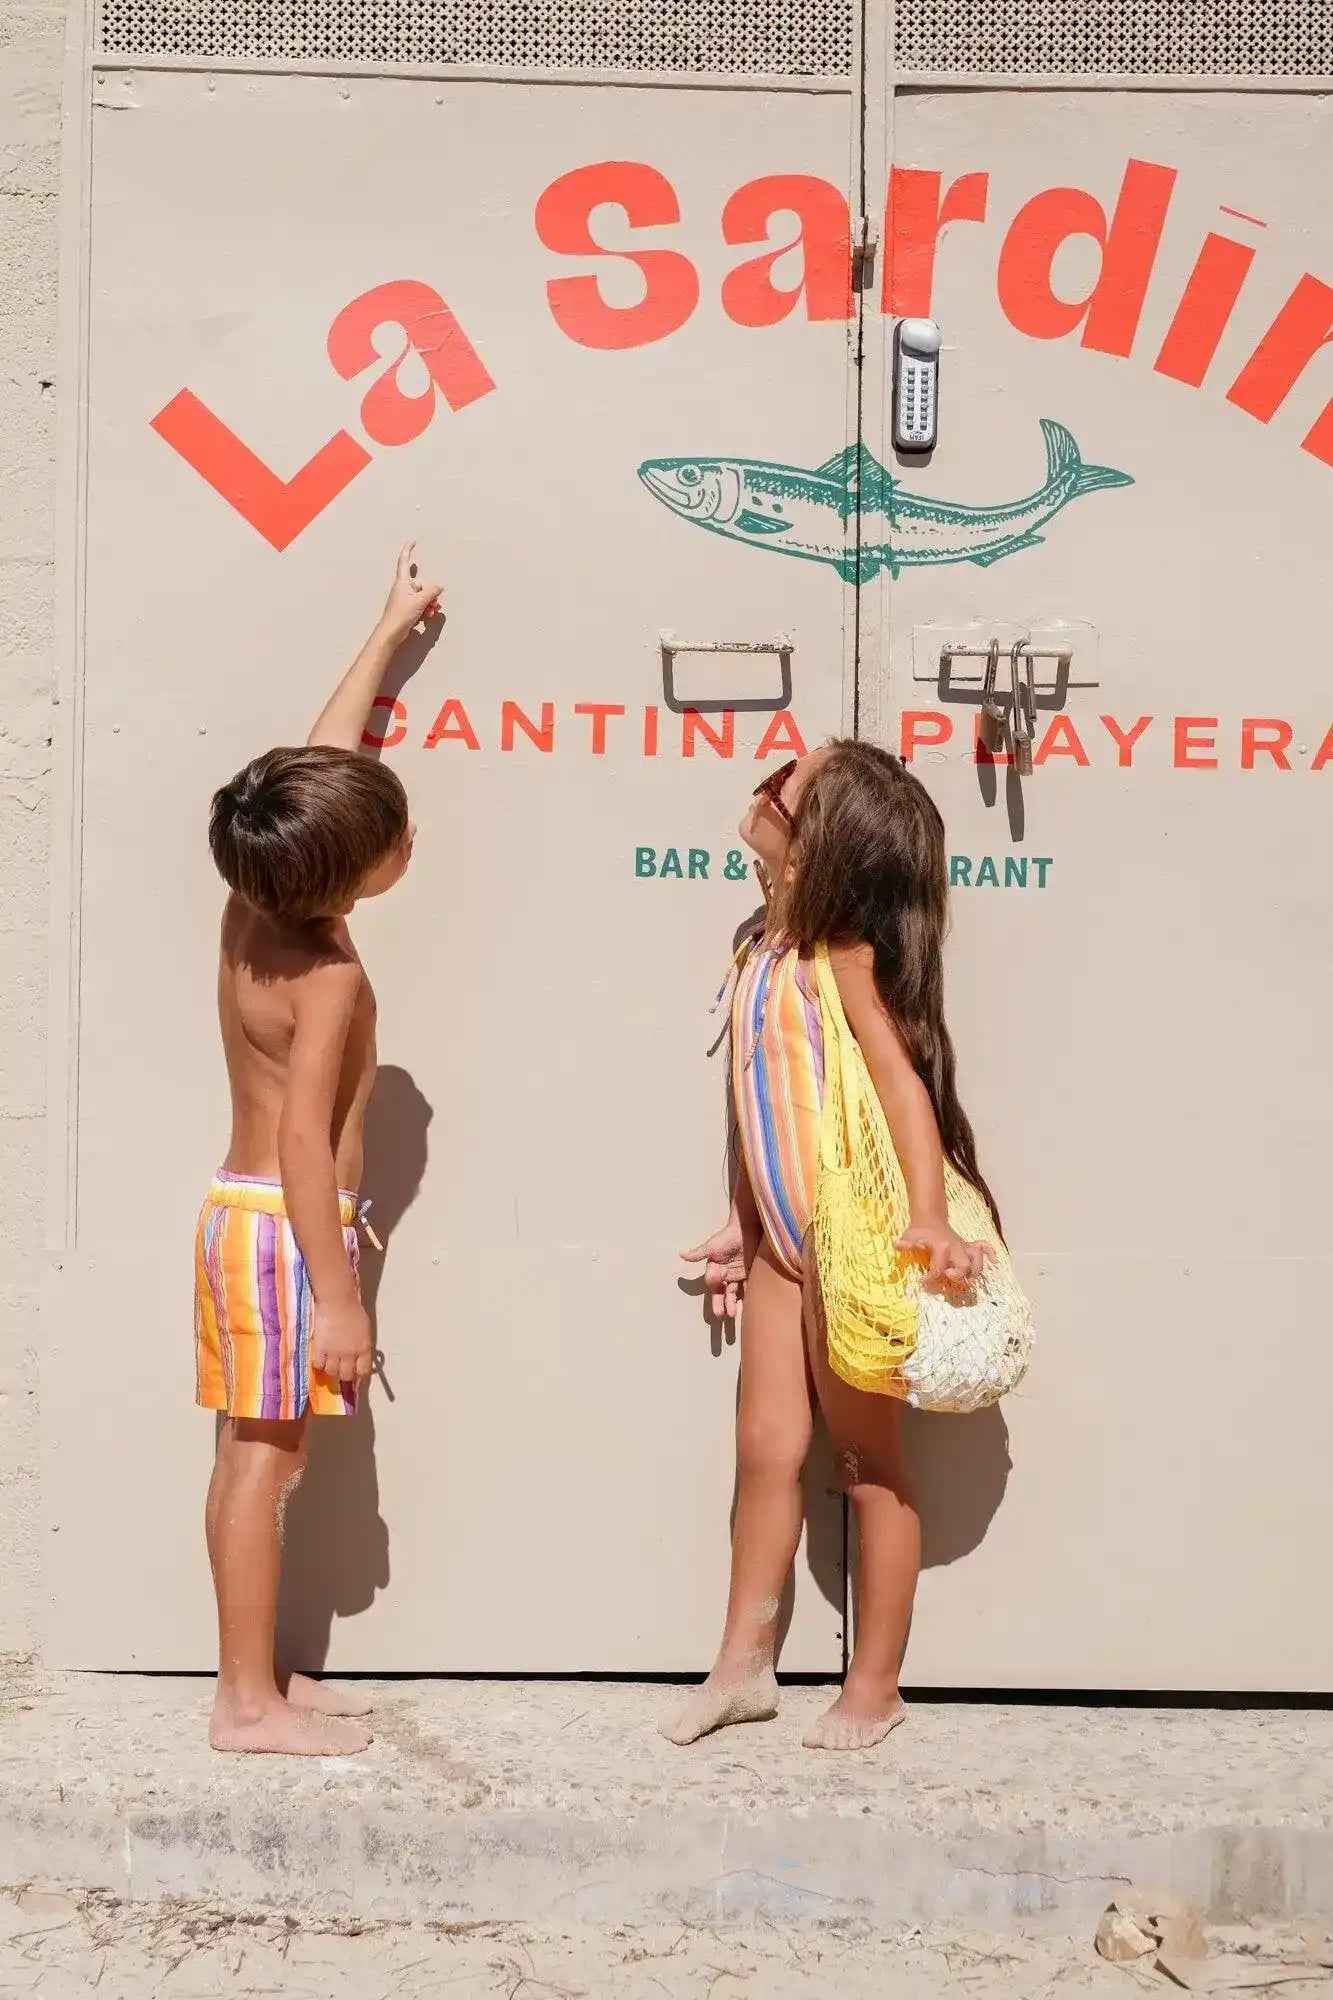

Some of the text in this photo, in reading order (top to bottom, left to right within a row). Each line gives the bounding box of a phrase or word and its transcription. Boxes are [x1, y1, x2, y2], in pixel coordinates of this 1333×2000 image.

[149, 278, 497, 553] La
[361, 695, 809, 761] CANTINA
[634, 846, 711, 880] BAR
[722, 849, 749, 881] &
